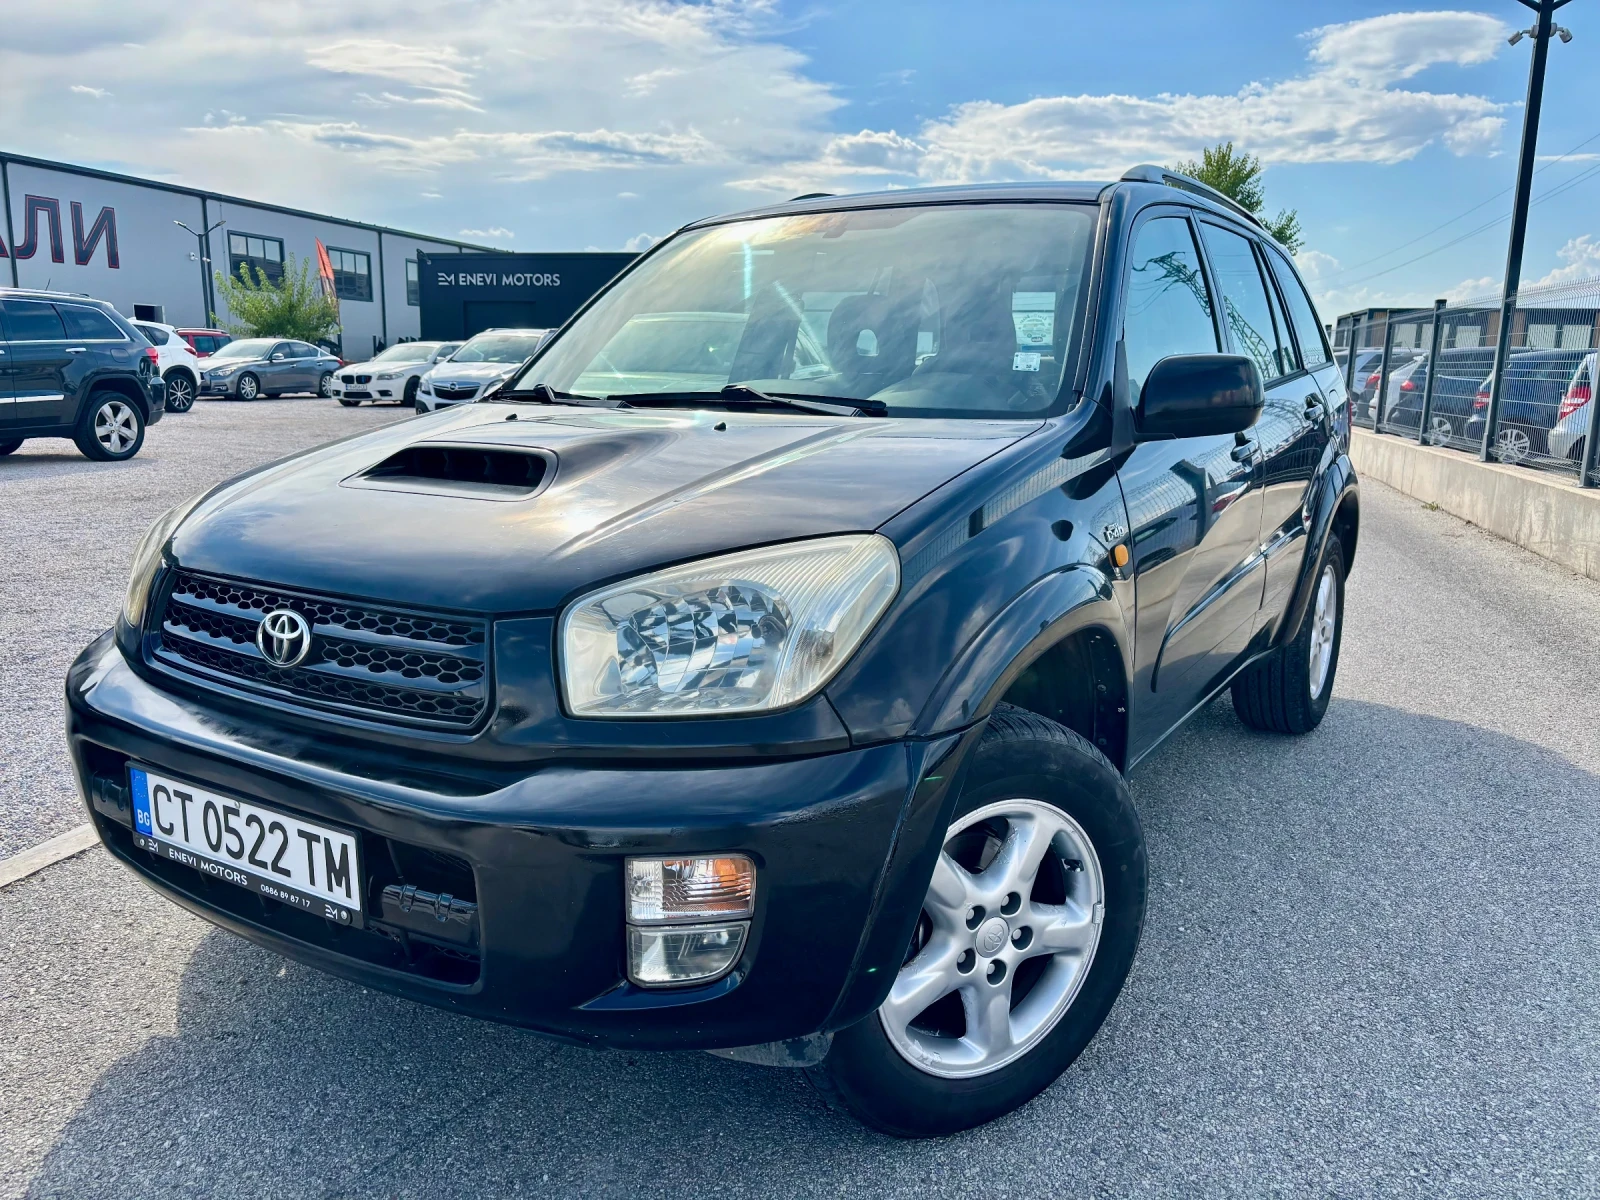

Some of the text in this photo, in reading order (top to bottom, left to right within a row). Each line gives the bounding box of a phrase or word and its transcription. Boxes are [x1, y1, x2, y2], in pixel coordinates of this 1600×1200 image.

[0, 194, 120, 269] ЛИ
[458, 273, 497, 286] ENEVI
[502, 273, 561, 286] MOTORS
[137, 808, 151, 827] BG
[152, 784, 354, 900] CT 0522 TM
[168, 847, 197, 867] ENEVI
[200, 860, 248, 886] MOTORS
[260, 884, 279, 897] 0886
[280, 891, 289, 900] 89
[290, 895, 299, 904] 87
[302, 898, 310, 908] 17
